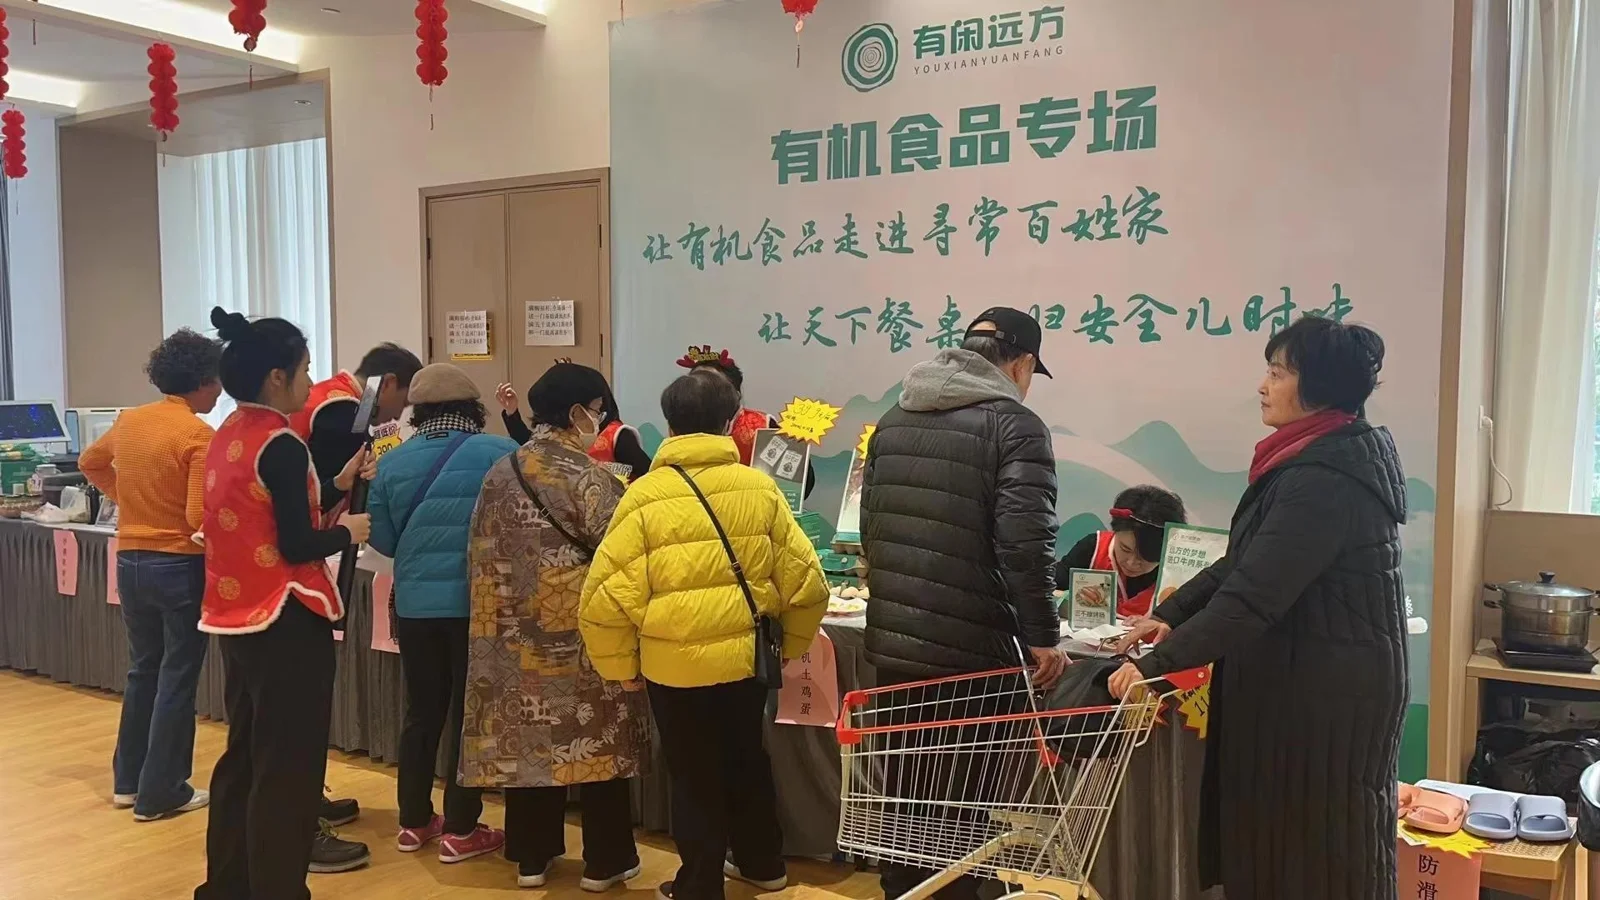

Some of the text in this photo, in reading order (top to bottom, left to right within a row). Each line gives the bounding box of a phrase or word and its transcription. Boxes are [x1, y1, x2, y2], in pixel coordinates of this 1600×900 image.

[913, 6, 1065, 59] 有闲远方
[914, 45, 1064, 75] YOUXIANYUANFANG
[770, 85, 1157, 184] 有机食品专场
[642, 185, 1169, 271] 让有机食品走进寻常百姓家
[757, 283, 1354, 353] 让天下餐桌归安全儿时味
